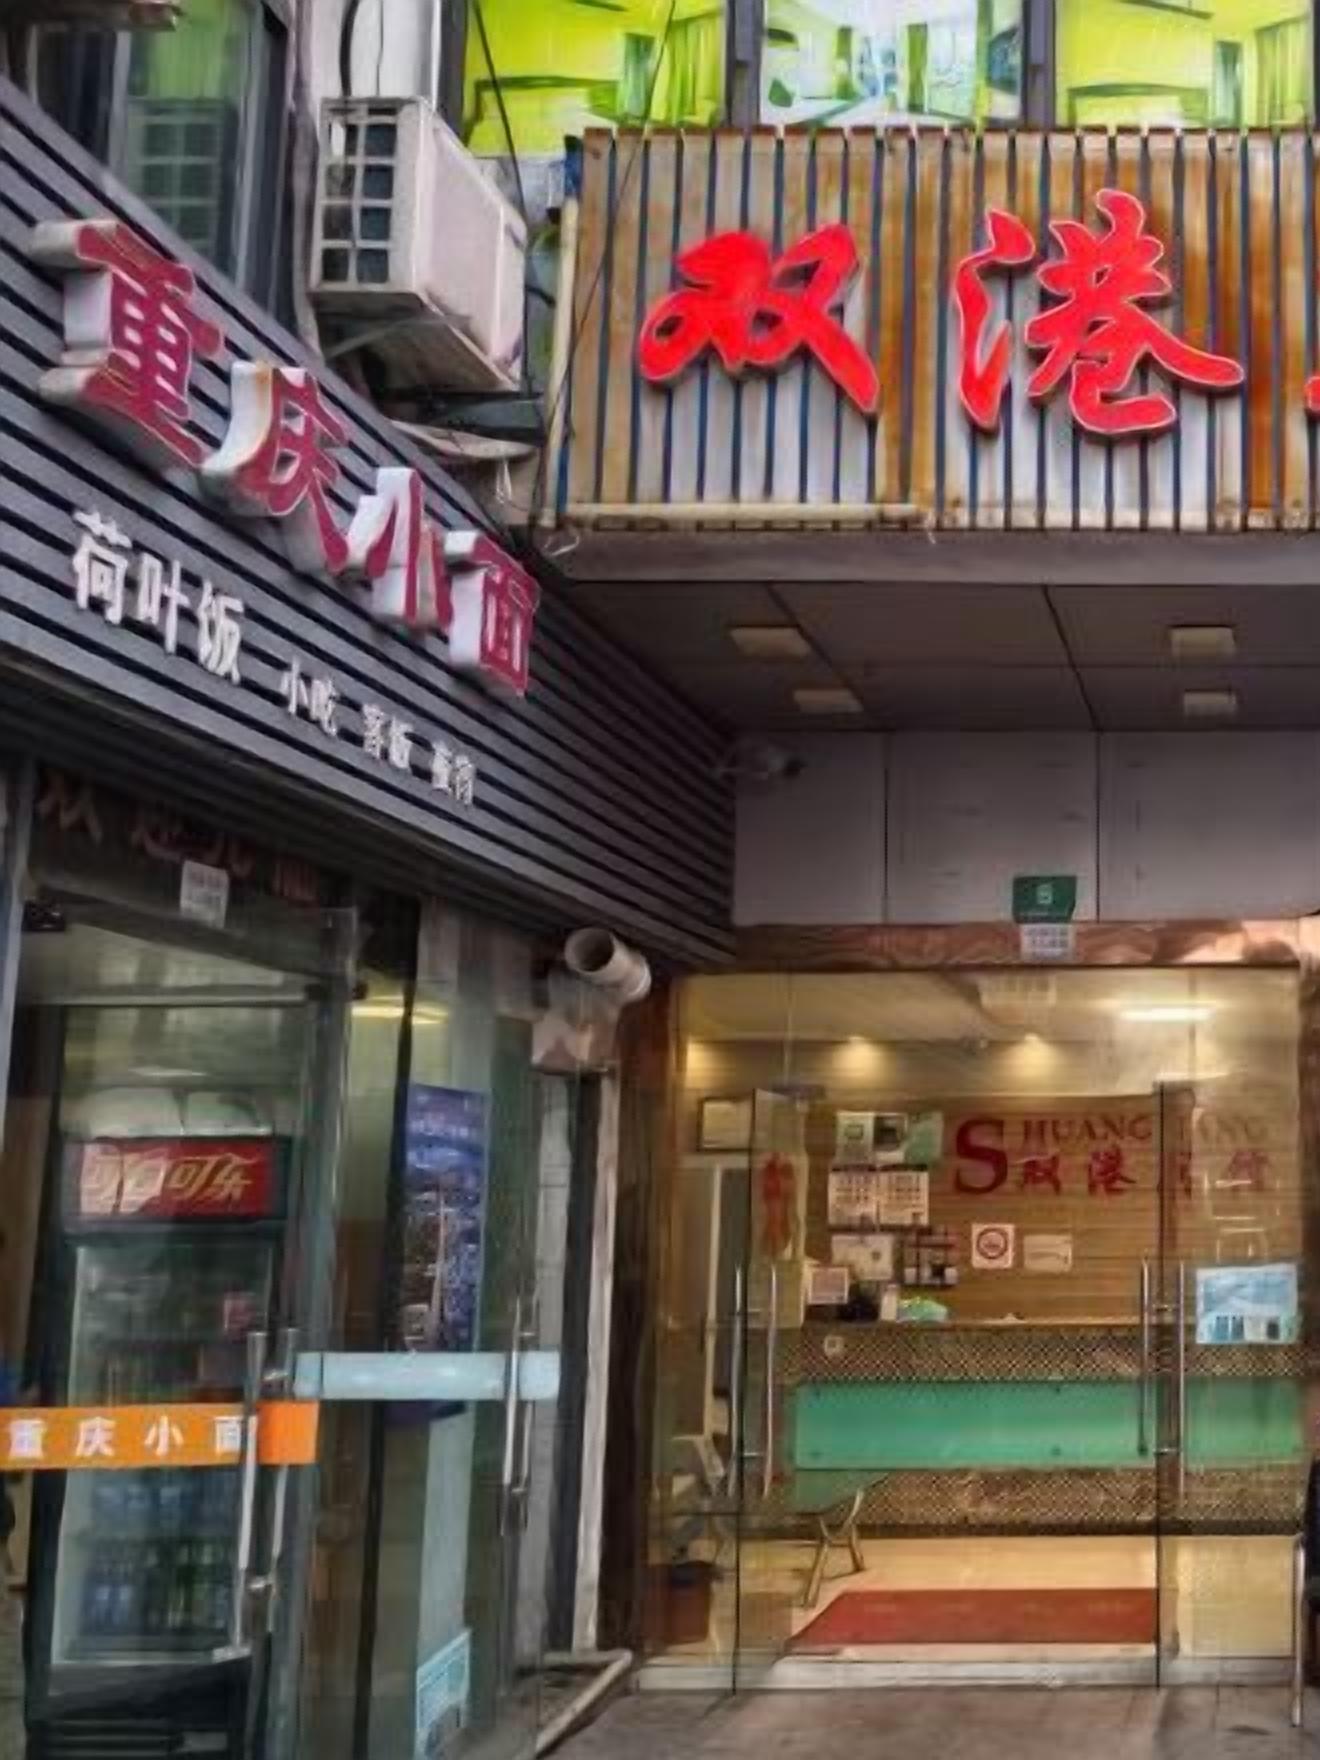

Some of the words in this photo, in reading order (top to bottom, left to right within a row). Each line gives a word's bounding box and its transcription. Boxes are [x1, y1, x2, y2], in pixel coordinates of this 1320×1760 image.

[34, 219, 541, 697] 重庆小面
[72, 507, 244, 684] 荷叶饭
